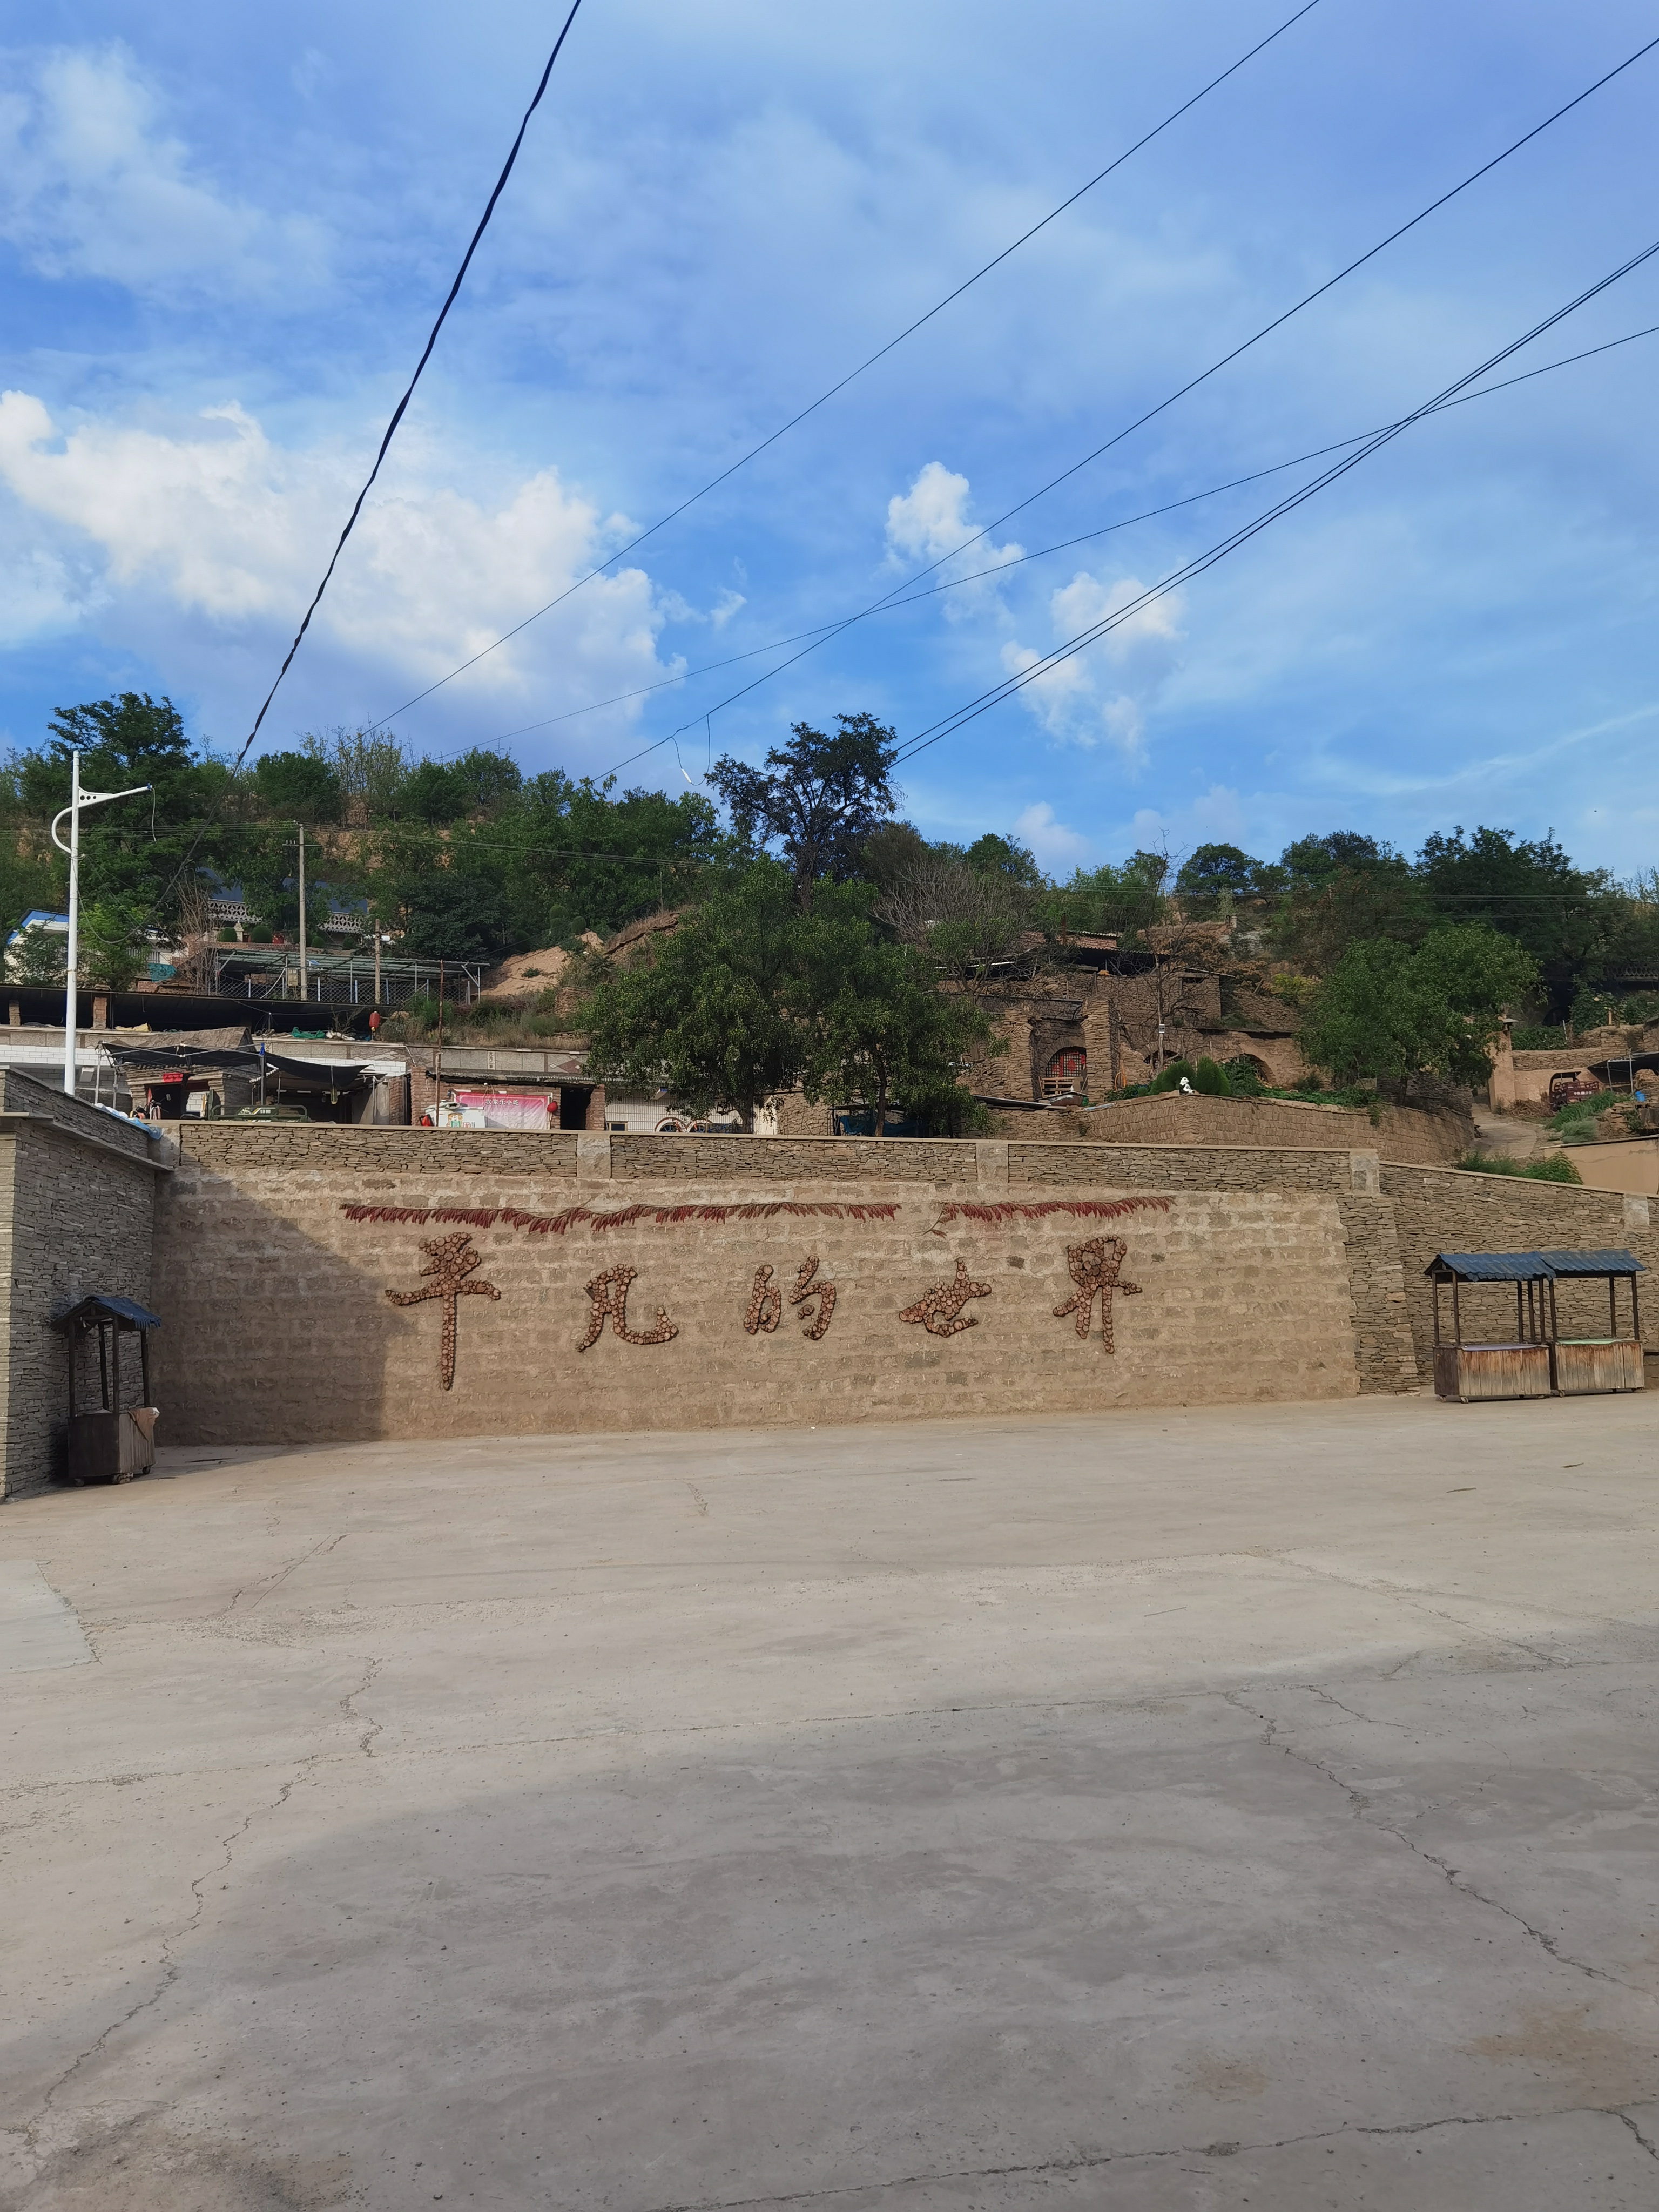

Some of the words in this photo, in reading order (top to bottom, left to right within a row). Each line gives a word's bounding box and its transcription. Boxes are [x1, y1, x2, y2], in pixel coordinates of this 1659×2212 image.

[385, 1232, 1143, 1391] 平凡的世界
